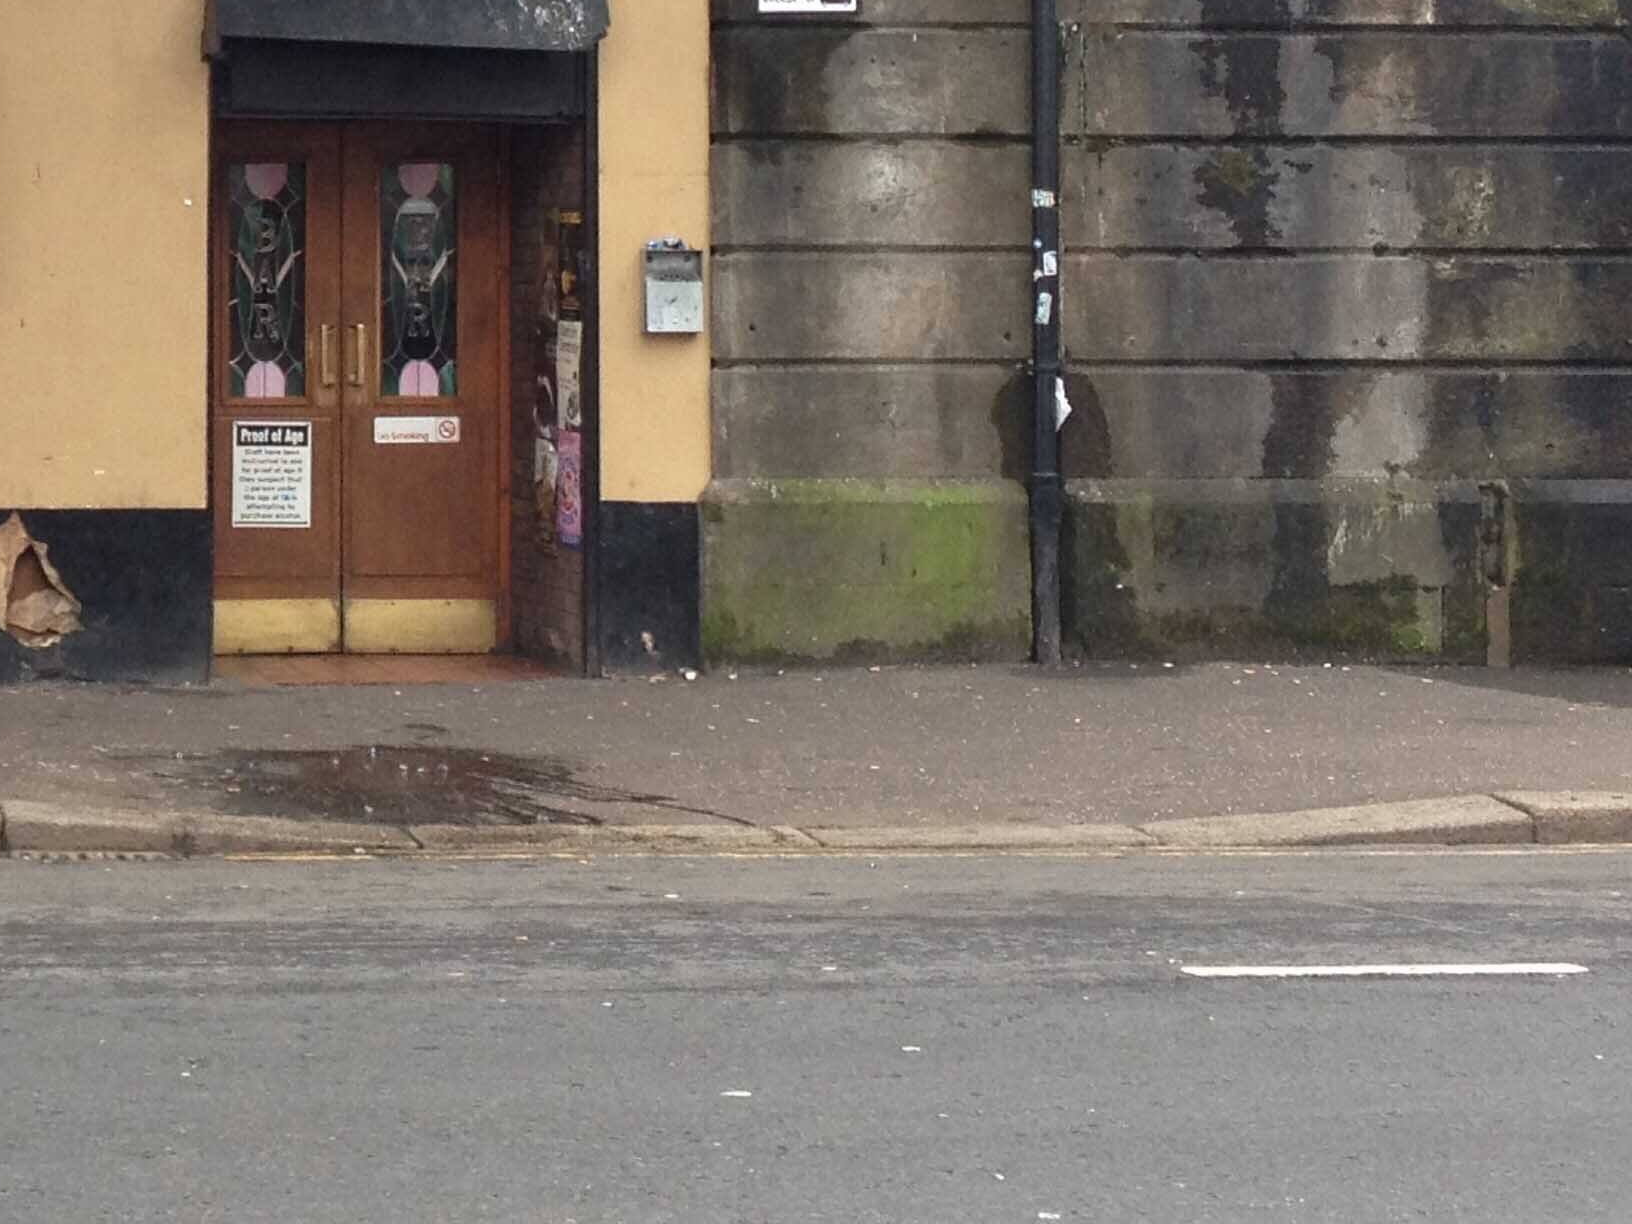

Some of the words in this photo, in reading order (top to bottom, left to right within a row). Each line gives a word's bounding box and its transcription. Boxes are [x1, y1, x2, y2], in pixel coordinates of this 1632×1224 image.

[240, 427, 269, 443] Proof
[271, 427, 283, 443] of
[284, 427, 305, 445] Age
